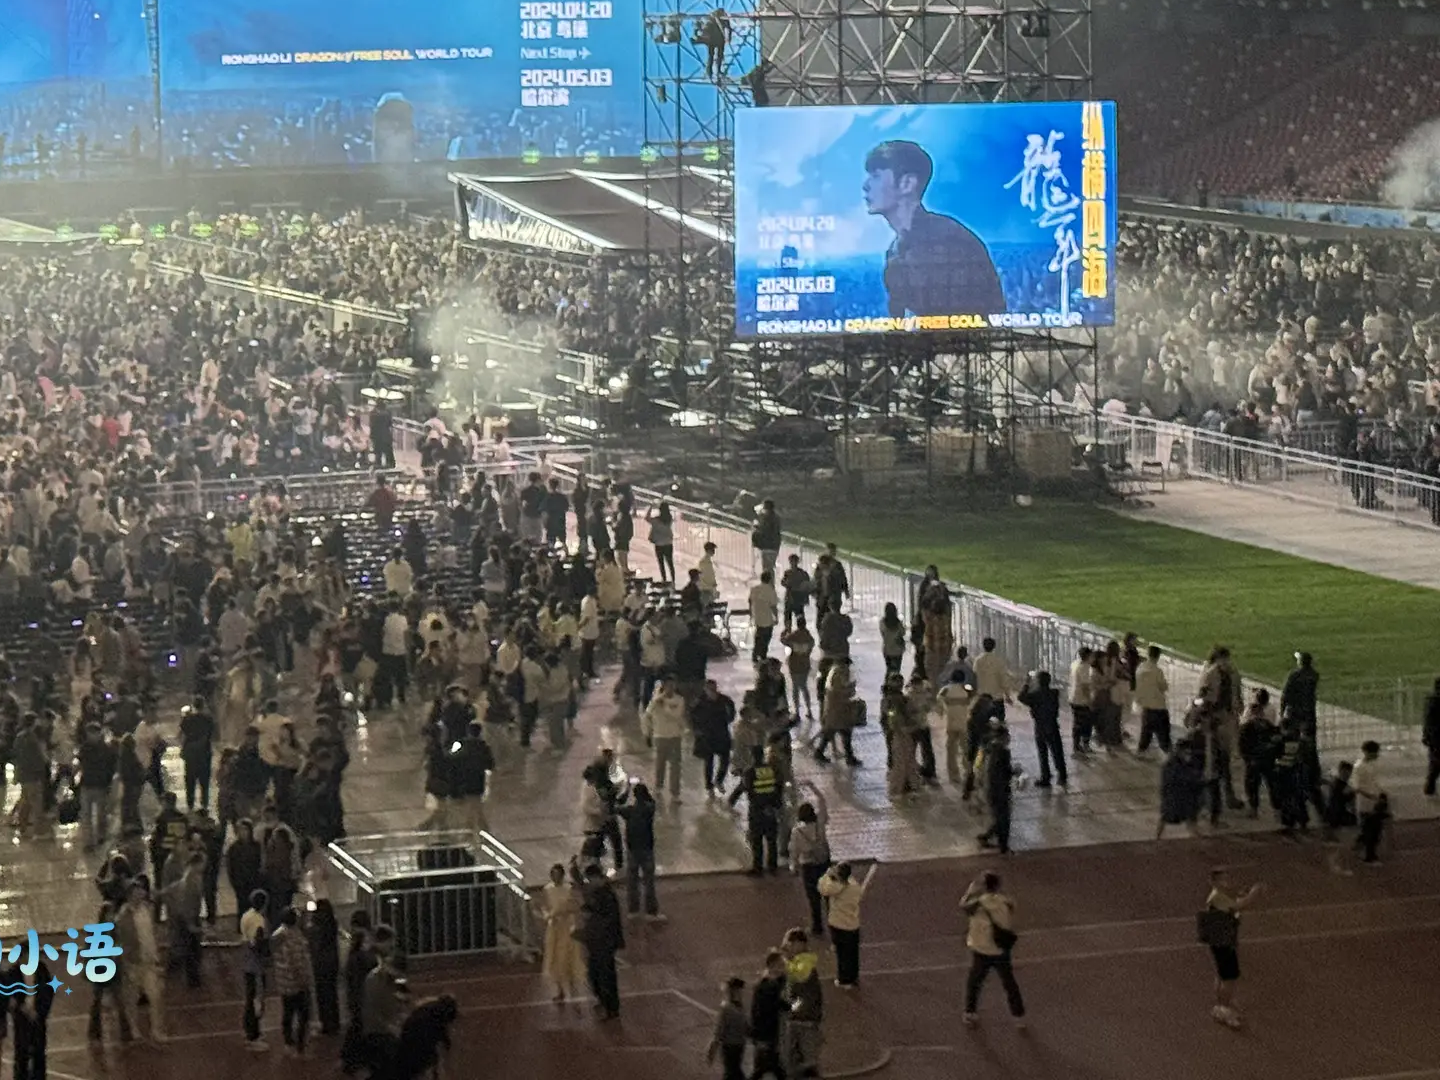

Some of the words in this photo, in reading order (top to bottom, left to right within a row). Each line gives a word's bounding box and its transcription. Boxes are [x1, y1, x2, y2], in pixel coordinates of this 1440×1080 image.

[520, 1, 612, 19] 2024.04.20
[415, 47, 459, 60] WORLD
[460, 47, 493, 59] TOUR
[521, 68, 613, 87] 2024.05.03
[756, 275, 836, 294] 2024.05.03
[757, 318, 826, 334] RONGHAO
[988, 313, 1041, 328] WORLD
